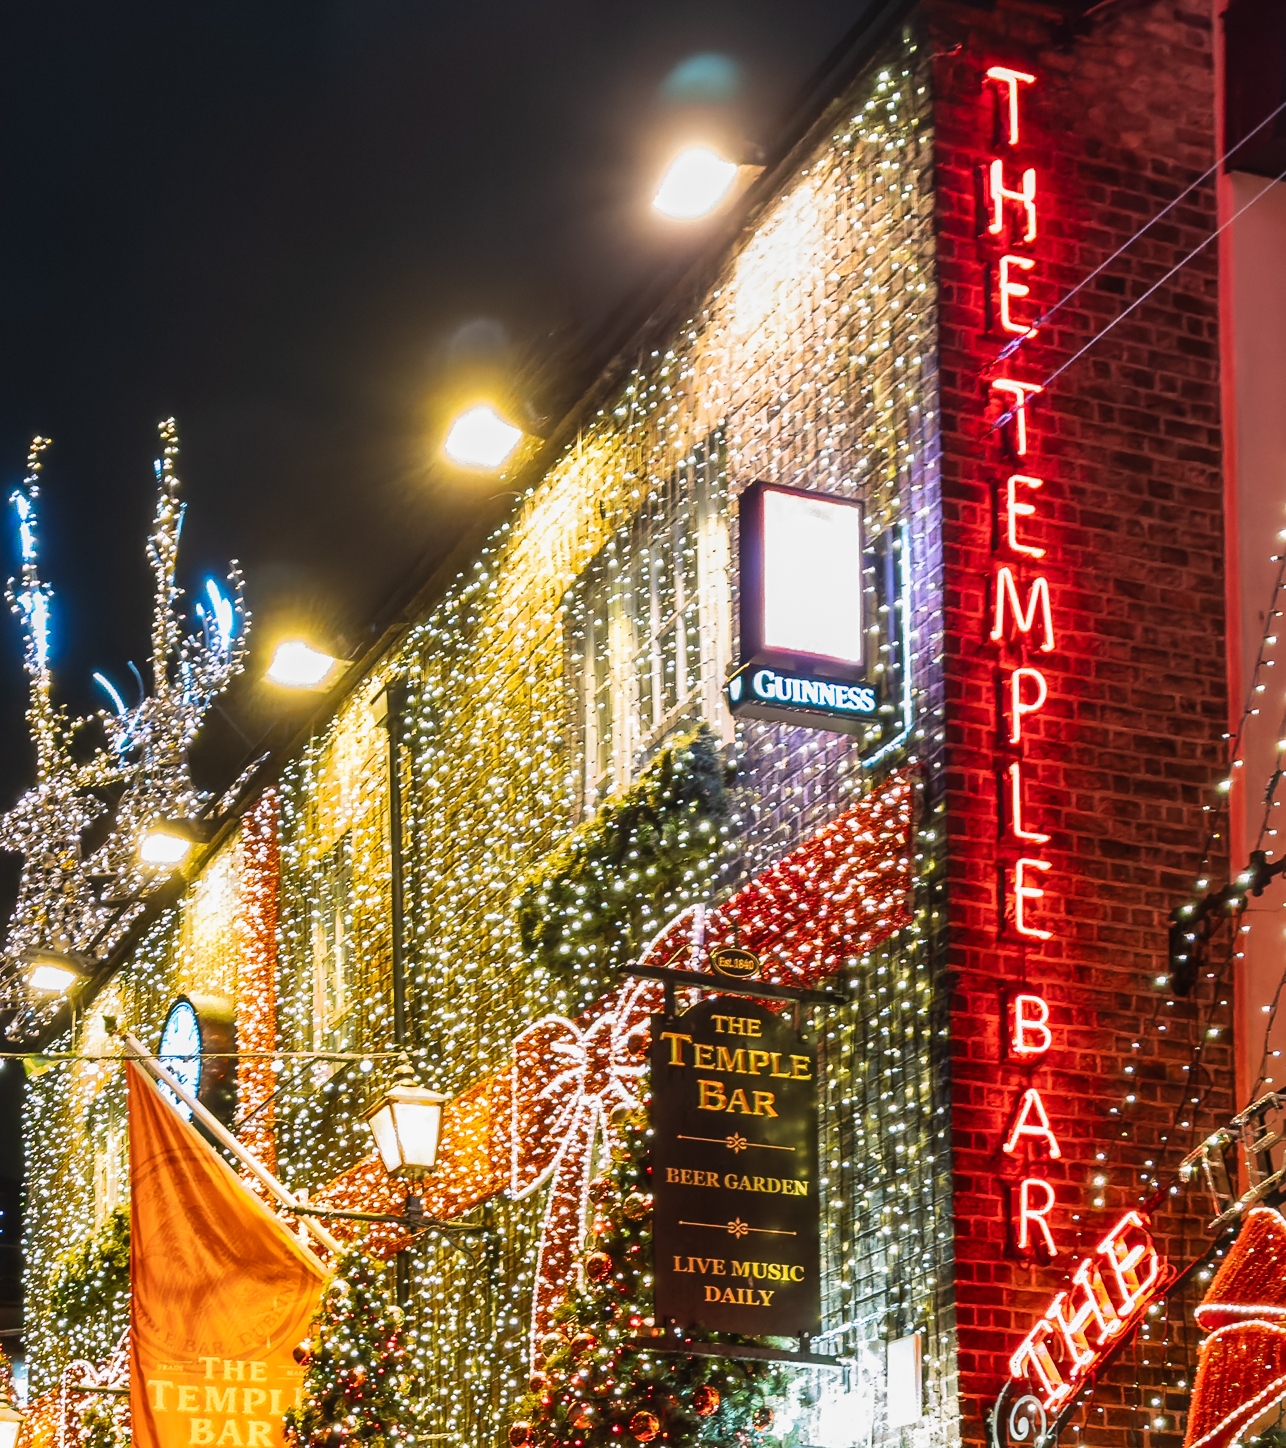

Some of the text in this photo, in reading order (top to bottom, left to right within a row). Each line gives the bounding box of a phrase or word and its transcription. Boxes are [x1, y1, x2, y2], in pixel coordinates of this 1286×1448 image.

[986, 65, 1061, 1258] THE TEMPLE BAR
[753, 669, 876, 713] GUINNESS
[711, 1014, 762, 1038] THE
[659, 1031, 813, 1081] TEMPLE
[696, 1079, 780, 1118] BAR
[665, 1167, 809, 1196] BEER GARDEN
[672, 1255, 805, 1282] LIVE MUSIC
[704, 1285, 775, 1307] DAILY
[1010, 1209, 1164, 1412] THE
[198, 1356, 269, 1382] THE
[189, 1417, 275, 1448] BAR
